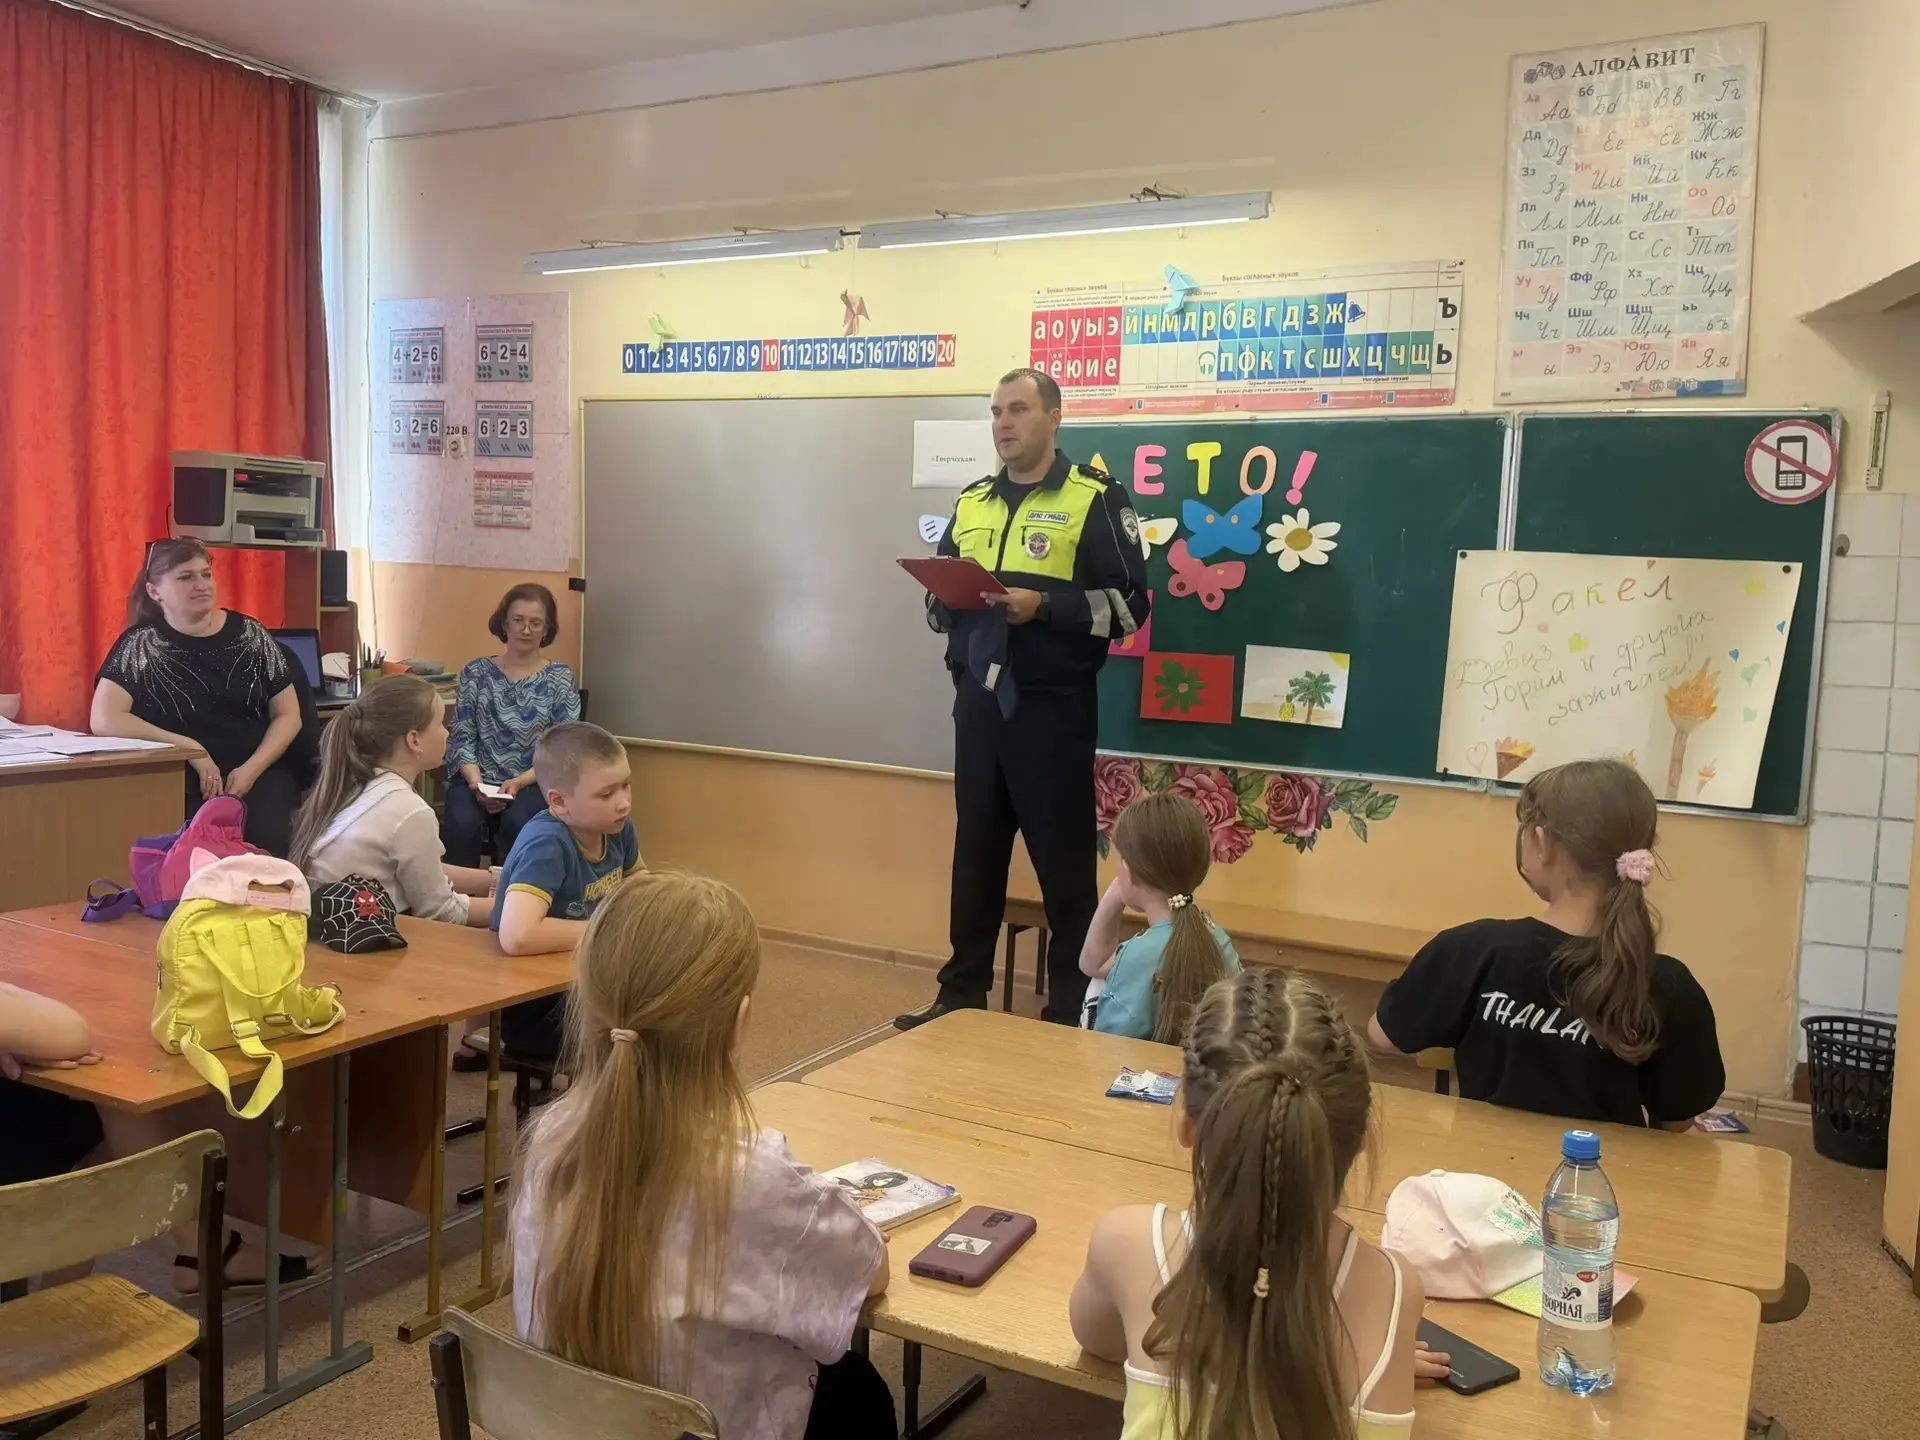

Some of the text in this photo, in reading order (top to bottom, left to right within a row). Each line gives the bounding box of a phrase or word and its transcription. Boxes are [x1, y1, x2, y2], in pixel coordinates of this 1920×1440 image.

[1572, 48, 1695, 78] АЛФАВИТ
[1692, 112, 1718, 121] Жж
[1690, 151, 1707, 160] Кк
[1631, 193, 1648, 202] Нн
[1574, 199, 1596, 208] Мм
[1711, 196, 1736, 216] Оо
[1629, 230, 1645, 240] Сс
[1518, 240, 1534, 249] Пп
[1572, 236, 1589, 246] Рр
[1628, 269, 1642, 278] Хх
[1685, 265, 1704, 275] Цц
[1570, 272, 1592, 283] Фф
[1568, 308, 1592, 317] Шш
[1625, 305, 1652, 314] Щщ
[1125, 302, 1344, 337] й н м л р б в г д з ж
[1515, 311, 1530, 320] Чч
[1034, 316, 1119, 345] а о у ы э
[1624, 341, 1650, 351] Юю
[625, 349, 633, 368] 0
[639, 349, 645, 368] 1
[666, 347, 674, 367] 3
[680, 347, 688, 367] 4
[694, 347, 701, 367] 5
[708, 346, 716, 367] 6
[723, 346, 730, 366] 7
[736, 345, 745, 366] 8
[751, 345, 759, 365] 9
[764, 344, 777, 365] 10
[782, 344, 794, 365] 11
[798, 343, 811, 365] 12
[814, 343, 827, 364] 13
[831, 343, 846, 364] 14
[850, 342, 864, 364] 15
[868, 342, 881, 363] 16
[884, 341, 898, 363] 17
[901, 340, 917, 363] 18
[920, 340, 935, 362] 19
[938, 340, 954, 362] 20
[1220, 344, 1430, 378] п ф к т с ш х ц ч щ
[1051, 354, 1062, 379] ё
[1067, 359, 1081, 379] ю
[1086, 359, 1098, 376] и
[1105, 357, 1117, 376] е
[1481, 570, 1672, 634] Факел
[1482, 671, 1565, 712] Горим
